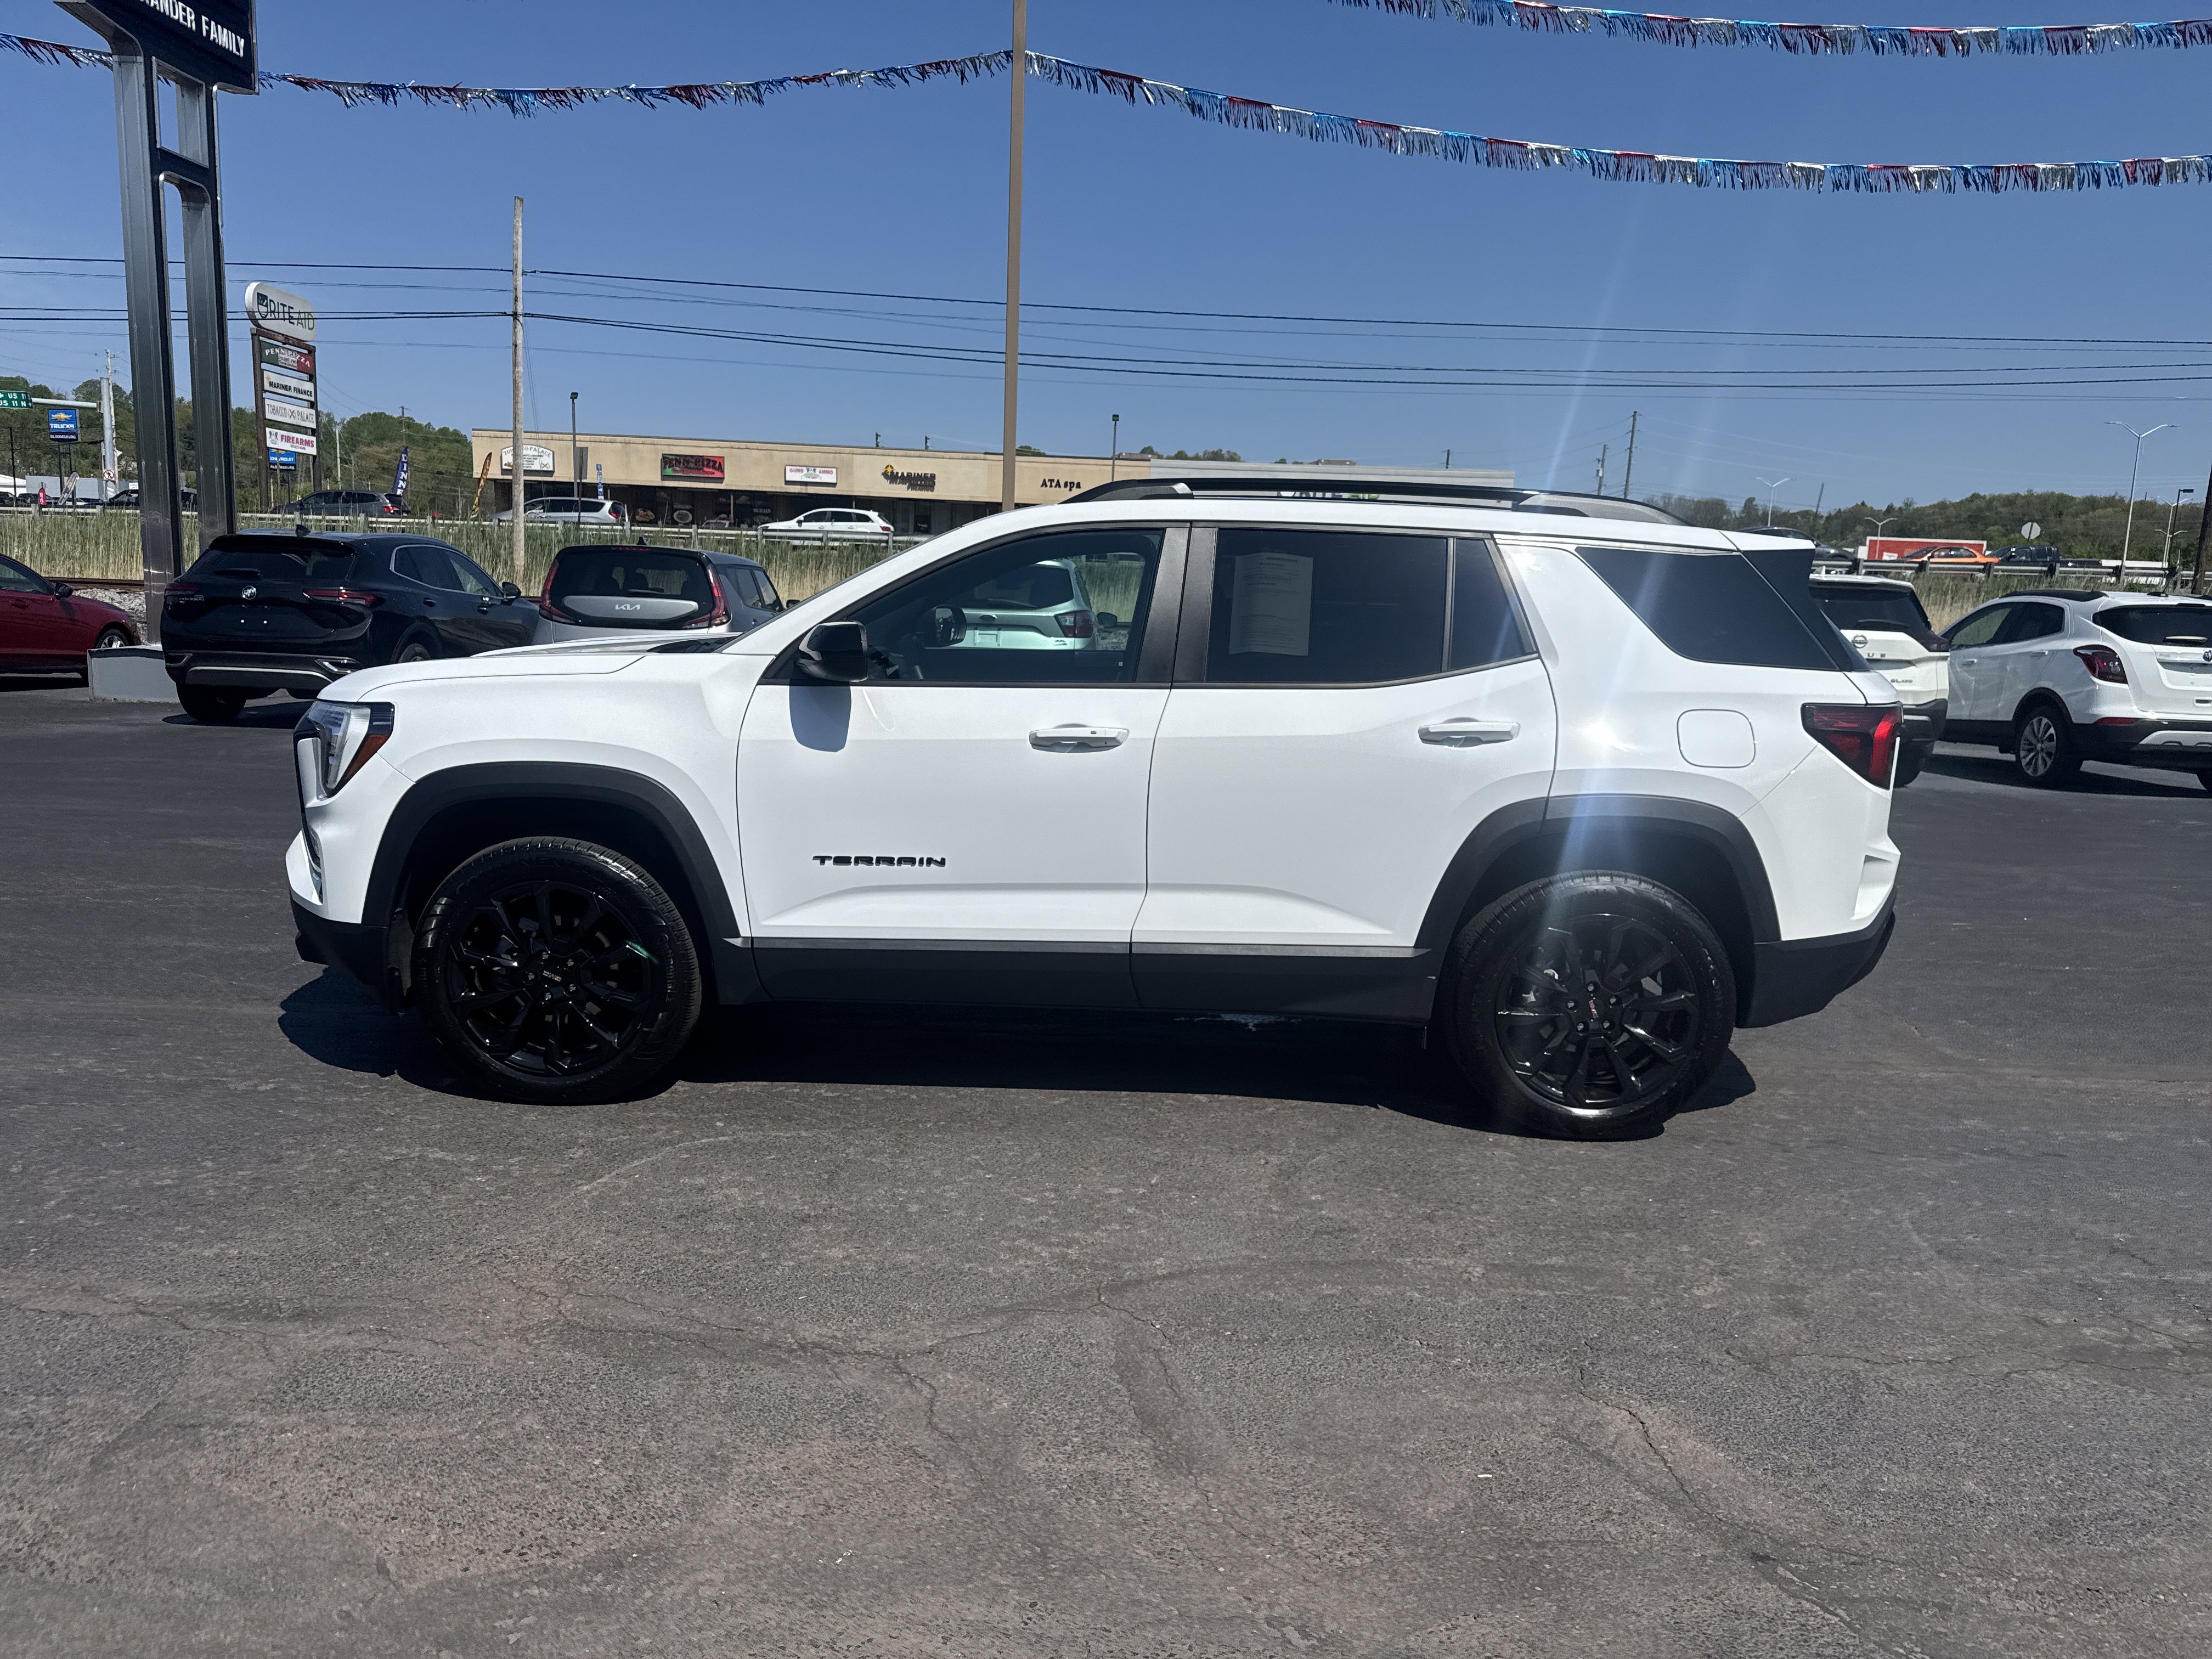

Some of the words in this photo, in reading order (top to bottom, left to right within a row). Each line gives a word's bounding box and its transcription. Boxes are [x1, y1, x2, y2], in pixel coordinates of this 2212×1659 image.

[201, 15, 245, 58] FAMILY
[269, 298, 295, 325] RITE
[297, 309, 315, 330] AID
[265, 347, 285, 356] PENN
[287, 349, 311, 368] PIZZA
[269, 380, 292, 392] MARINER
[293, 386, 313, 397] FINANCE
[267, 403, 287, 417] TOBACCO
[297, 410, 314, 424] PALACE
[280, 434, 314, 448] FIREARMS
[889, 471, 936, 480] MARINER
[1040, 478, 1062, 488] ATA
[1064, 481, 1081, 492] spa
[812, 855, 946, 867] TERRAIN
